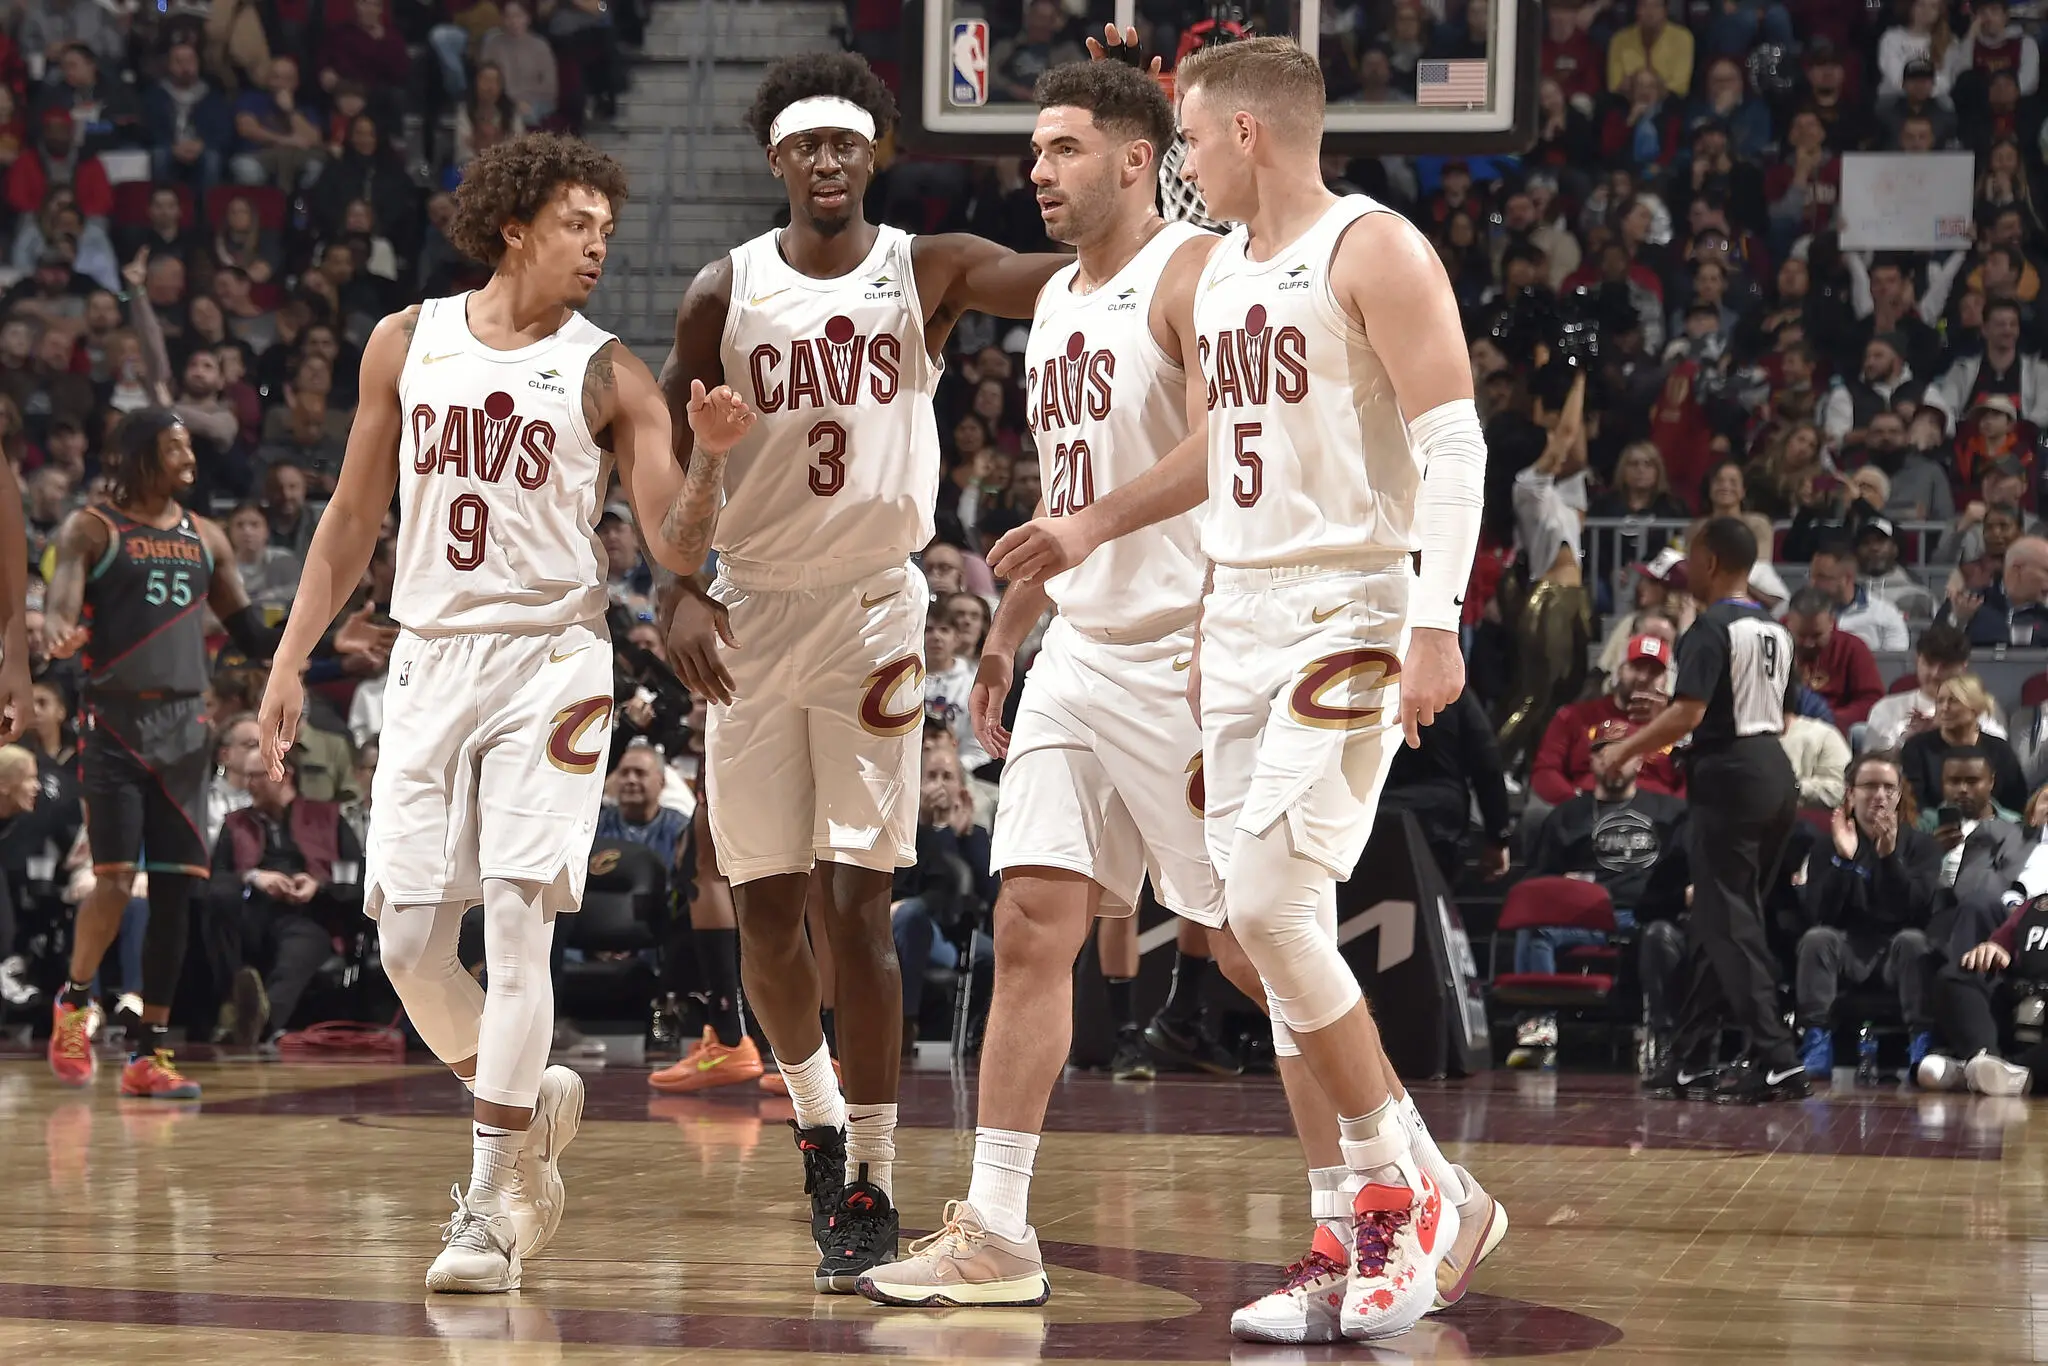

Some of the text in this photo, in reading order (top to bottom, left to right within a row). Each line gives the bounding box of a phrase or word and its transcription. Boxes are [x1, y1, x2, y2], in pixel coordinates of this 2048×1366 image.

[864, 290, 901, 300] CLIFFS
[1107, 302, 1137, 312] CLIFFS
[1278, 280, 1310, 291] CLIFFS
[528, 380, 566, 395] CLIFFS
[750, 333, 901, 414] CAVS
[1026, 349, 1116, 435] CAVS
[1198, 325, 1309, 412] CAVS
[412, 403, 557, 491] CAVS
[808, 420, 847, 497] 3
[1050, 439, 1095, 518] 20
[1233, 422, 1264, 509] 5
[446, 493, 490, 572] 9
[145, 569, 192, 607] 55
